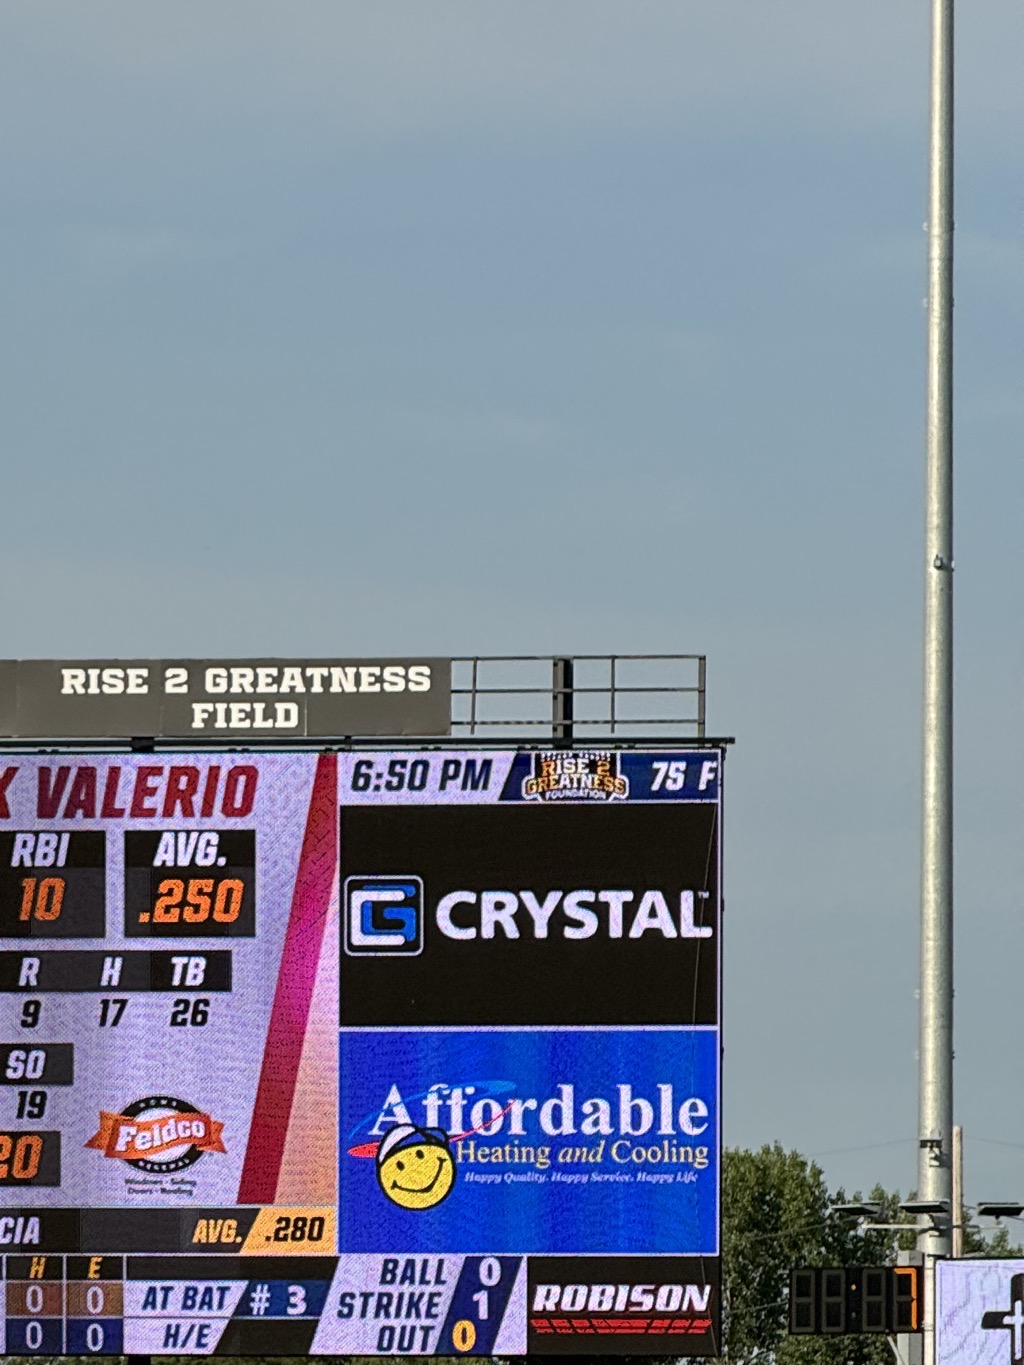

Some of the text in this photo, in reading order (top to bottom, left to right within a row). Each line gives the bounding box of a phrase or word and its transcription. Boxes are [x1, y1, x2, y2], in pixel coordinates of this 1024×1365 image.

[61, 666, 431, 694] RISE 2 GREATNESS
[191, 703, 299, 728] FIELD
[351, 759, 493, 792] 6:50 PM
[541, 758, 611, 776] RISE 2
[650, 760, 717, 791] 75 F
[36, 766, 259, 819] VALERIO
[527, 774, 626, 794] GREATNESS
[545, 787, 606, 799] FOUNDATION
[11, 833, 68, 867] RBI
[153, 832, 227, 866] AVG.
[19, 878, 66, 921] 10
[138, 878, 244, 923] .250
[435, 890, 713, 939] CRYSTAL
[18, 958, 40, 986] R
[100, 958, 123, 986] H
[170, 957, 207, 986] TB
[20, 1000, 41, 1028] 9
[99, 999, 128, 1027] 17
[169, 999, 209, 1027] 26
[5, 1050, 45, 1079] SO
[15, 1091, 47, 1119] 19
[368, 1082, 709, 1136] Affordable
[114, 1118, 206, 1152] Feldco
[457, 1140, 709, 1168] Heating and Cooling
[464, 1172, 501, 1183] Happy
[551, 1172, 587, 1182] Happy
[637, 1172, 673, 1182] Happy
[193, 1217, 325, 1243] AVG. .280
[30, 1257, 46, 1278] H
[88, 1257, 103, 1278] E
[380, 1257, 501, 1286] BALL 0
[27, 1285, 43, 1312] 0
[87, 1285, 103, 1314] 0
[141, 1285, 307, 1315] AT BAT # 3
[337, 1290, 488, 1319] STRIKE 1
[532, 1284, 711, 1312] ROBISON
[26, 1321, 42, 1349] 0
[87, 1323, 103, 1351] 0
[163, 1325, 210, 1348] H/E
[377, 1320, 476, 1352] OUT 0
